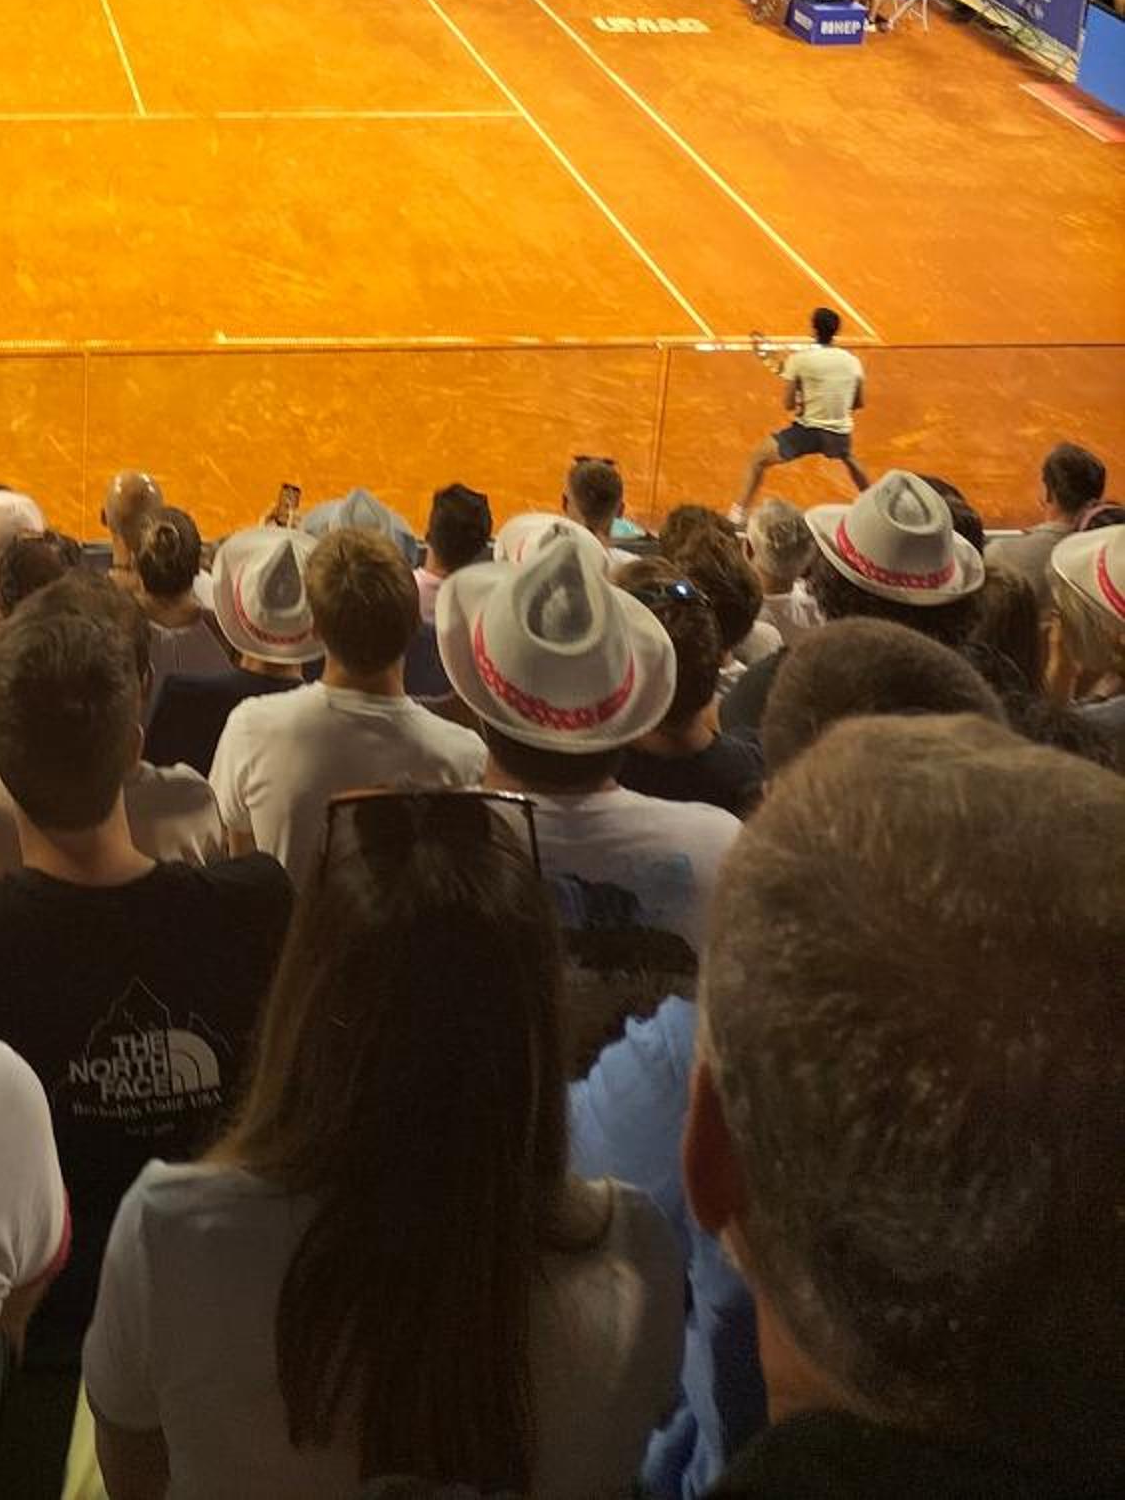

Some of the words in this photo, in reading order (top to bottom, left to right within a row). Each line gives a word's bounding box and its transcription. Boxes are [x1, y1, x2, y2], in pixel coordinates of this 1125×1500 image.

[111, 1030, 168, 1063] THE
[68, 1053, 171, 1085] NORTH
[100, 1074, 172, 1103] FACE
